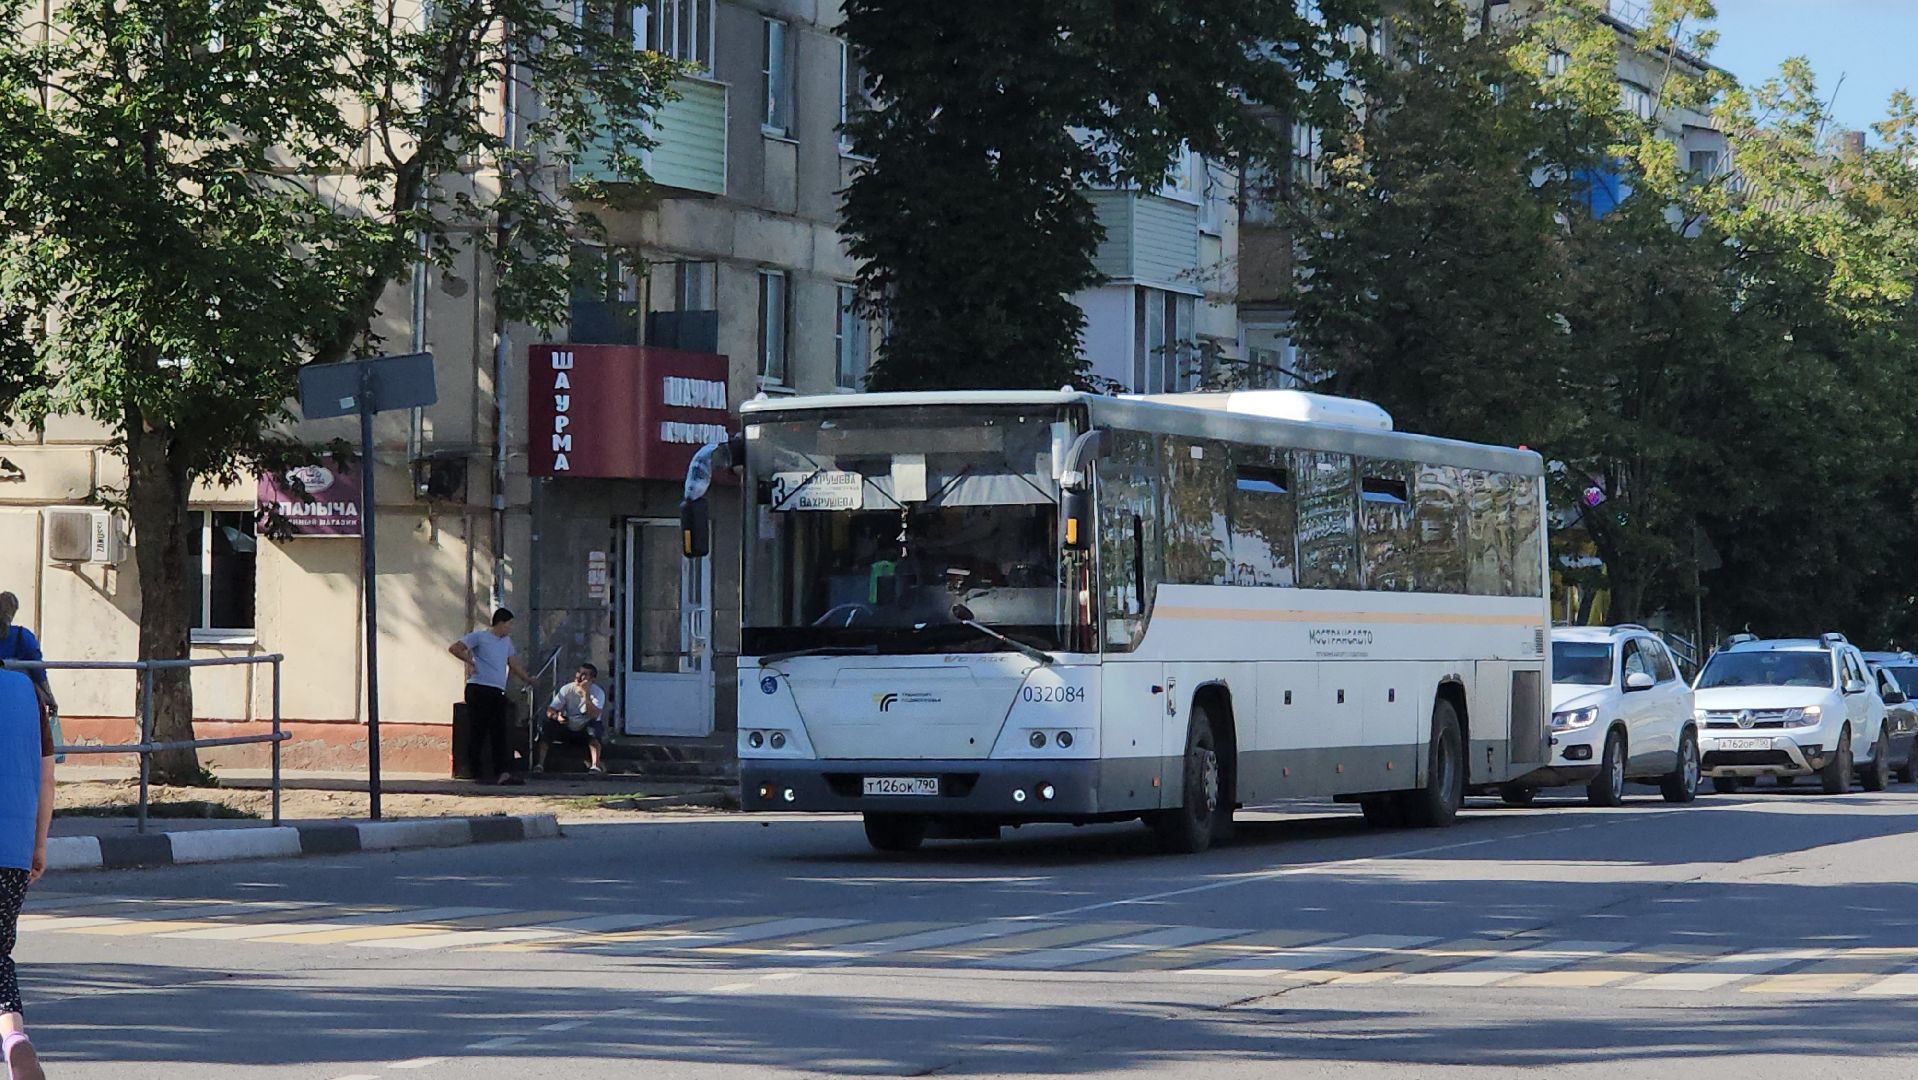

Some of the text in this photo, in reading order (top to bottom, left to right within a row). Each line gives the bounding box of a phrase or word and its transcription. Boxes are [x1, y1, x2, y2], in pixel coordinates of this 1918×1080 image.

[552, 352, 573, 470] ШАУРМА
[278, 502, 358, 516] ПАЛЫЧА
[1023, 686, 1085, 702] 032084
[867, 780, 914, 793] Т126ОК
